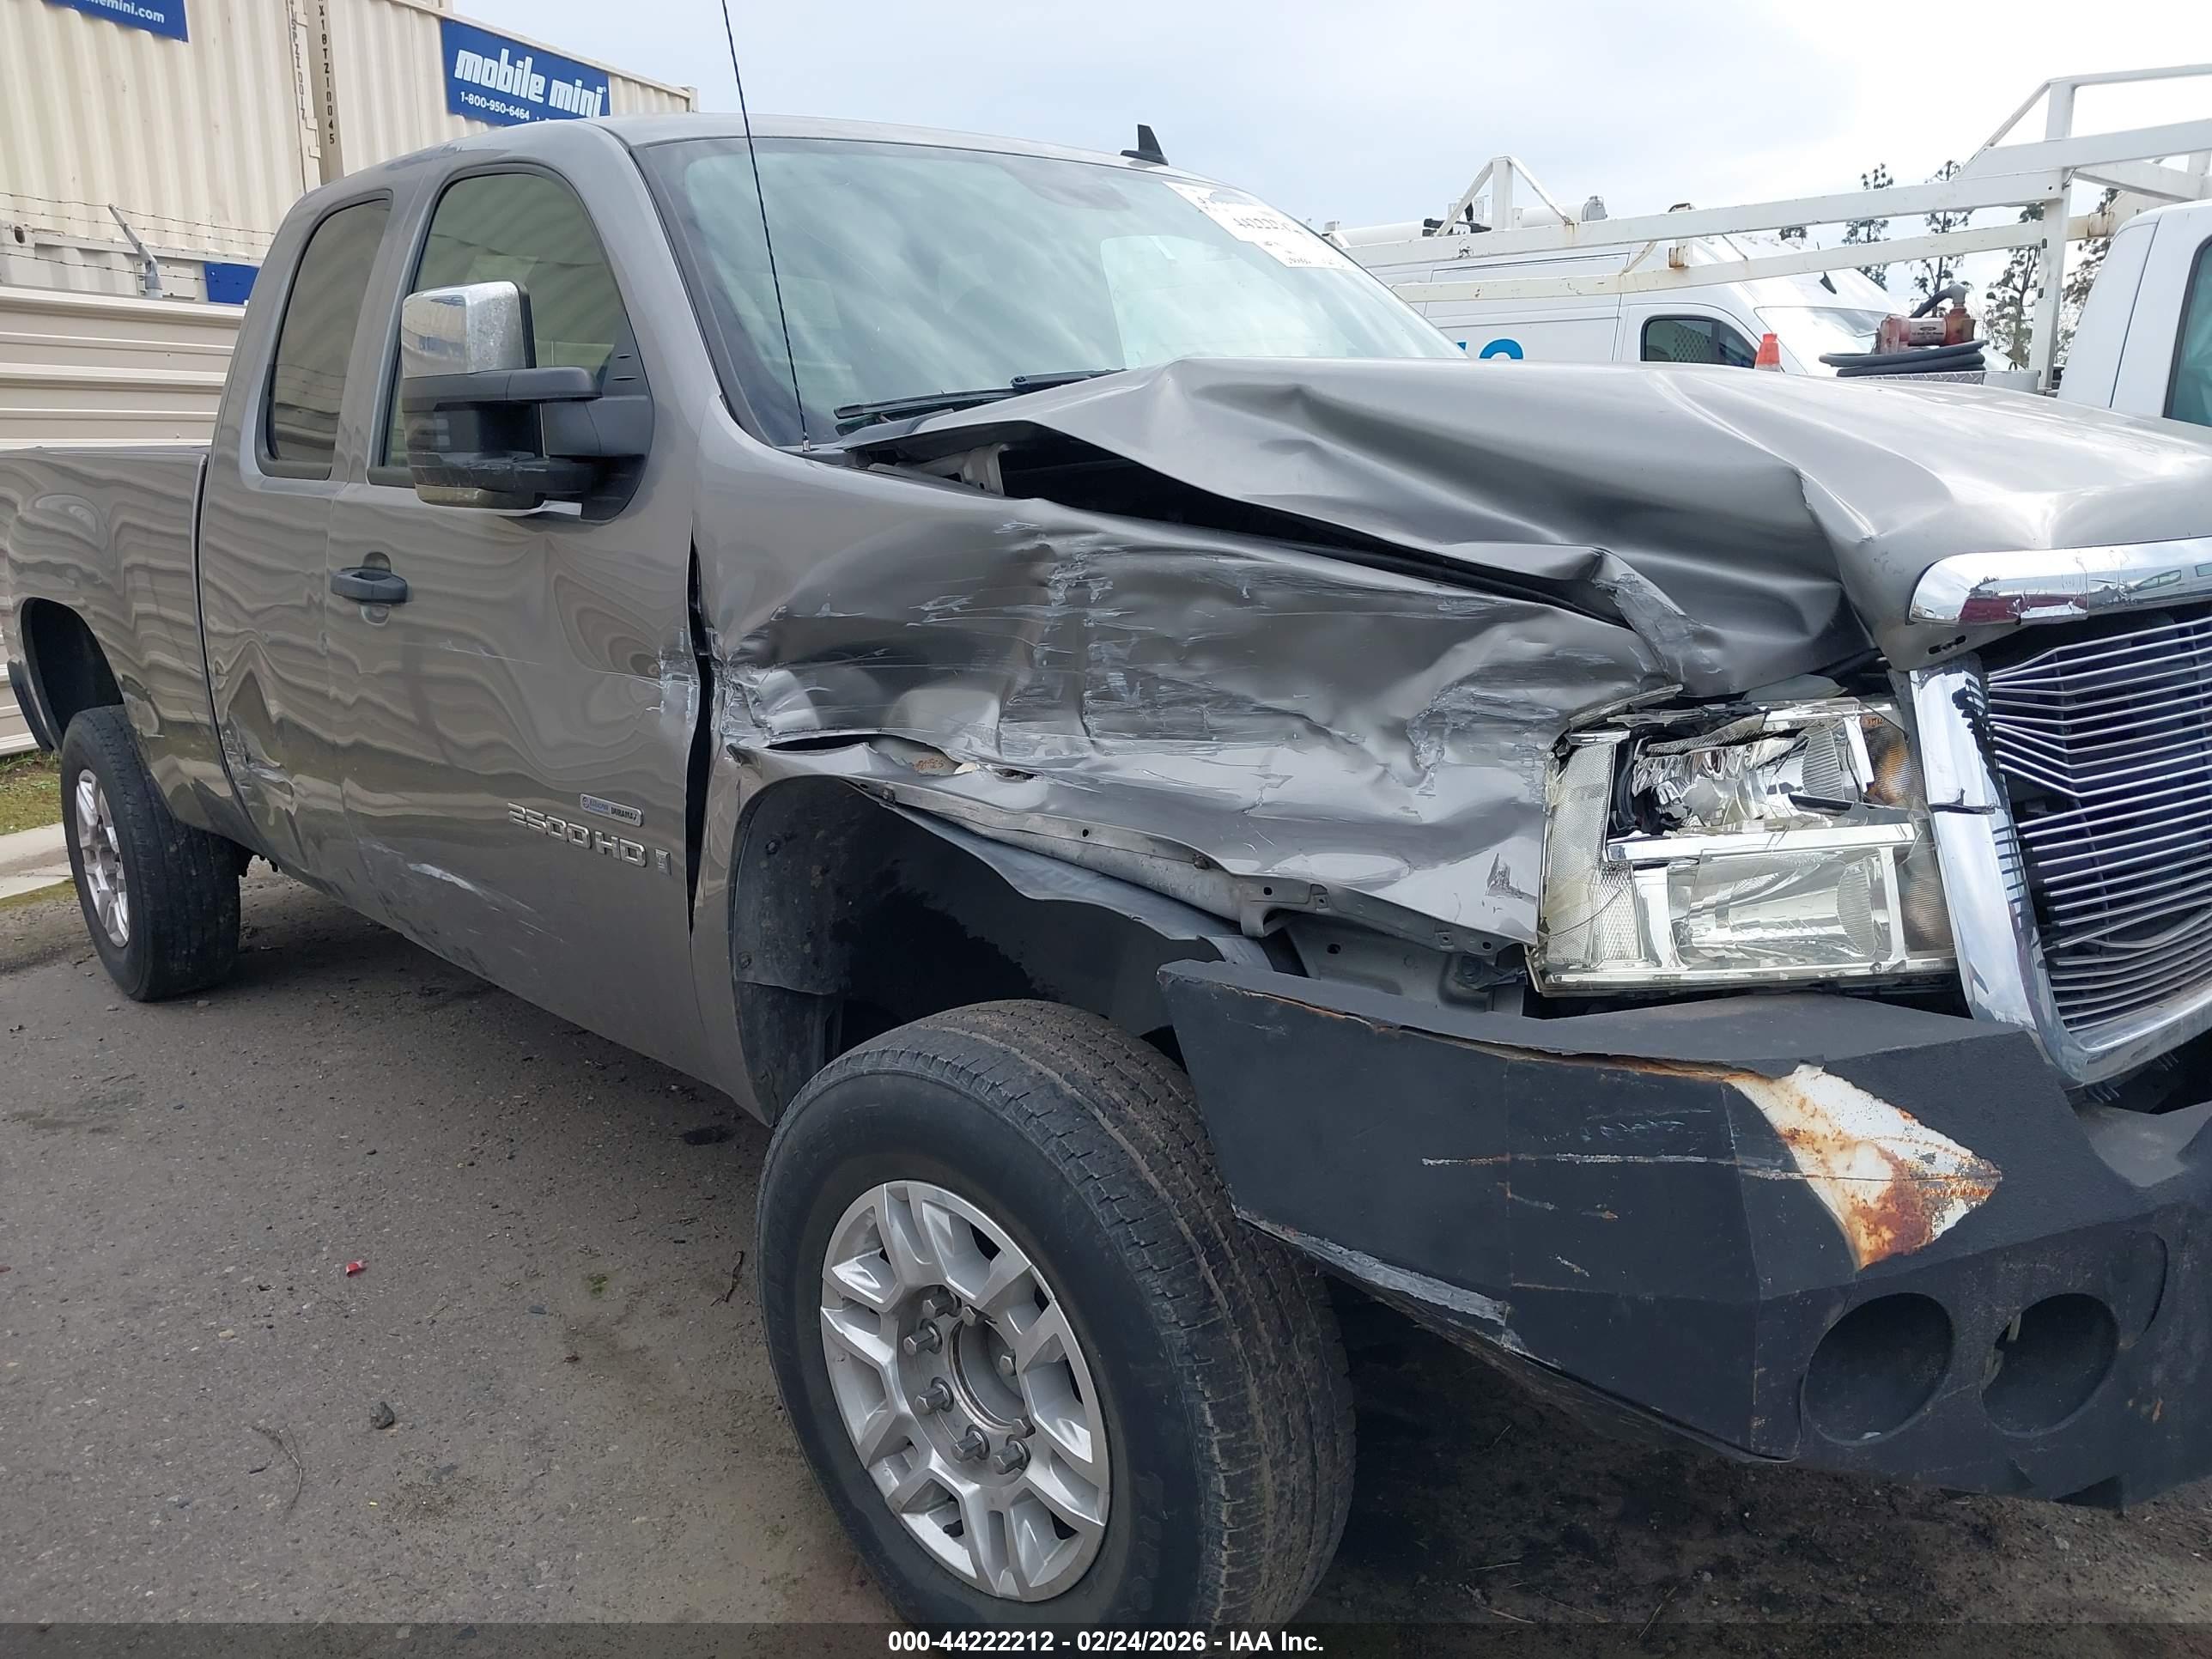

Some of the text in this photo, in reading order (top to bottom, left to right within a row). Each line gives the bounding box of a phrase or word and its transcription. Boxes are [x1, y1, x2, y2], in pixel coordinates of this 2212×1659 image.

[454, 48, 546, 104] mobile
[460, 91, 531, 121] 1-800-950-6464
[507, 802, 592, 849] 2500
[594, 830, 647, 867] HD
